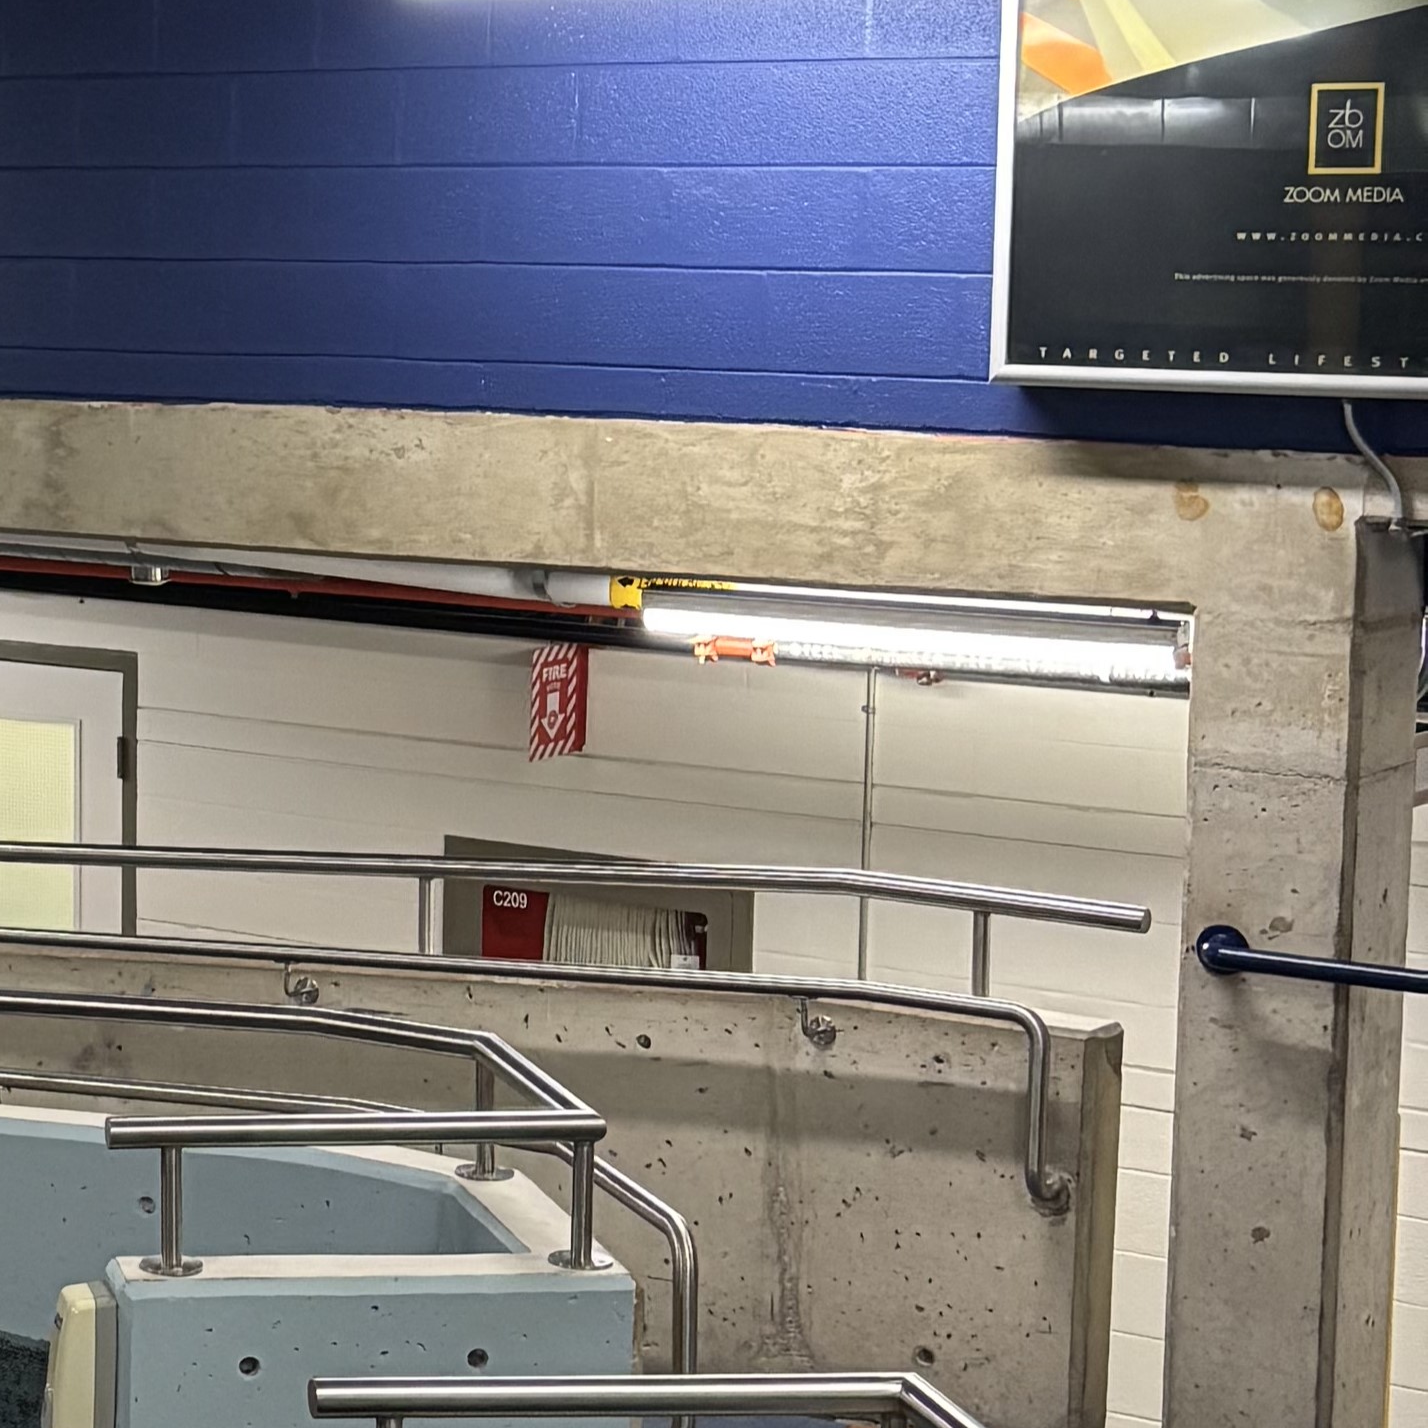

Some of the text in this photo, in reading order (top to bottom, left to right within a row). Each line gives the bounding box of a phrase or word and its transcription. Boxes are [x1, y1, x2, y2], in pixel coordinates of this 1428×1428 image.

[1283, 186, 1405, 204] ZOOM MEDIA
[1039, 346, 1428, 369] TARGETED LIFEST
[542, 663, 567, 682] FIRE
[493, 890, 528, 909] C209
